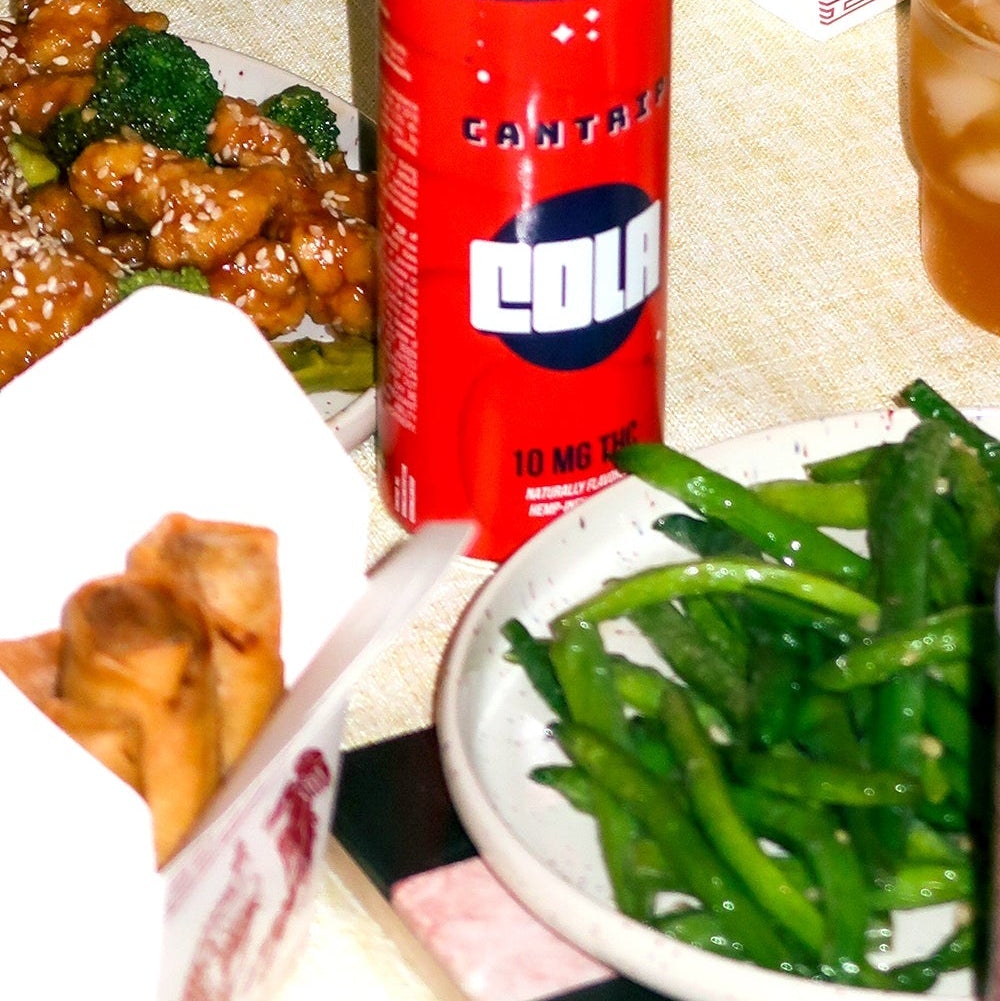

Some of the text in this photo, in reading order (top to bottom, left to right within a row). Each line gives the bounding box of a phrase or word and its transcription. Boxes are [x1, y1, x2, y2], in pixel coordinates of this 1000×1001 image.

[470, 199, 662, 335] COLA
[513, 447, 544, 477] 10
[552, 440, 592, 475] MG
[525, 482, 586, 501] NATURALLY
